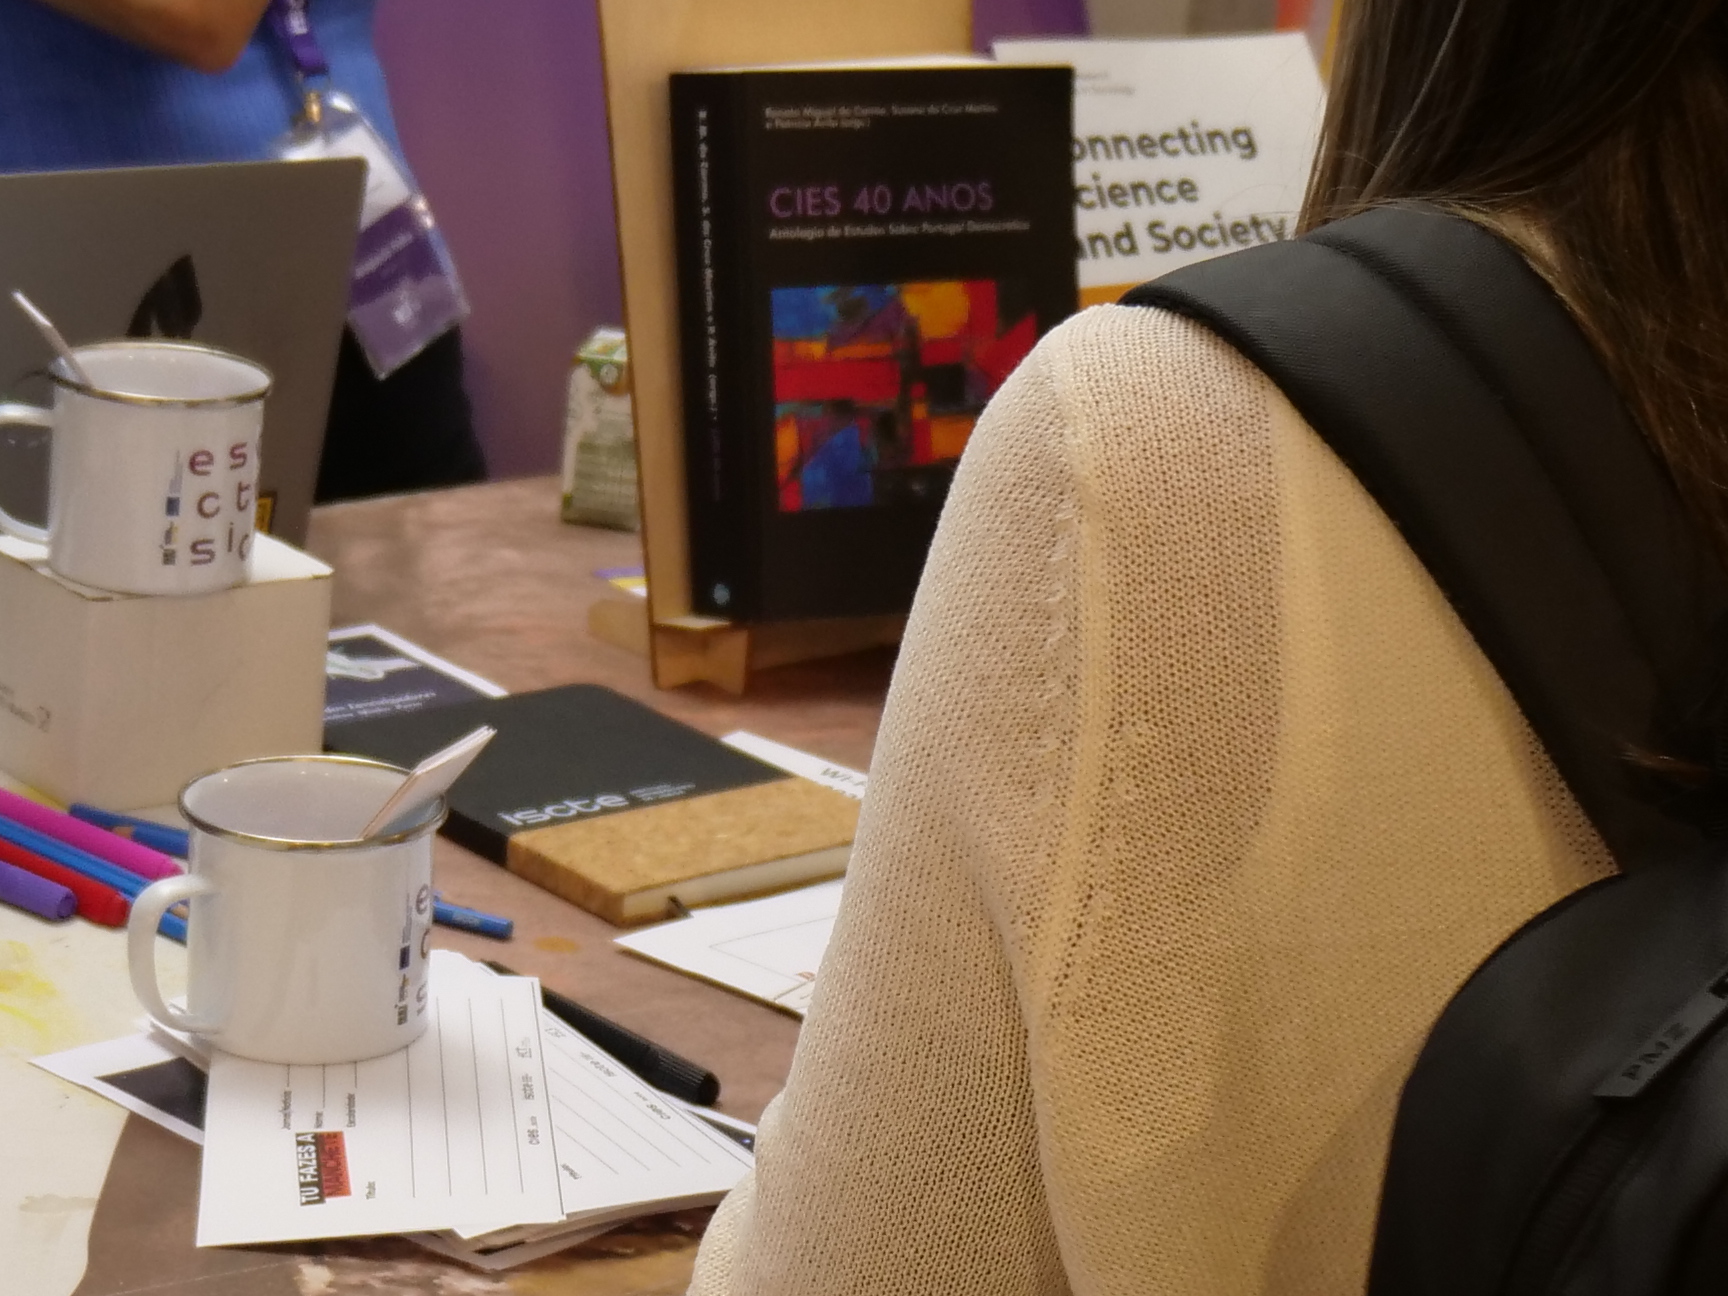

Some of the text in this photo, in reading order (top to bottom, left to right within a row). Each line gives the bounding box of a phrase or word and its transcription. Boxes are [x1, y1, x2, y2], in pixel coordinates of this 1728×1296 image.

[1072, 119, 1258, 161] onnecting
[770, 180, 995, 218] CIES 40 ANOS
[1073, 171, 1200, 210] cience
[496, 791, 631, 827] iscte
[296, 1132, 321, 1204] TU FAZES A
